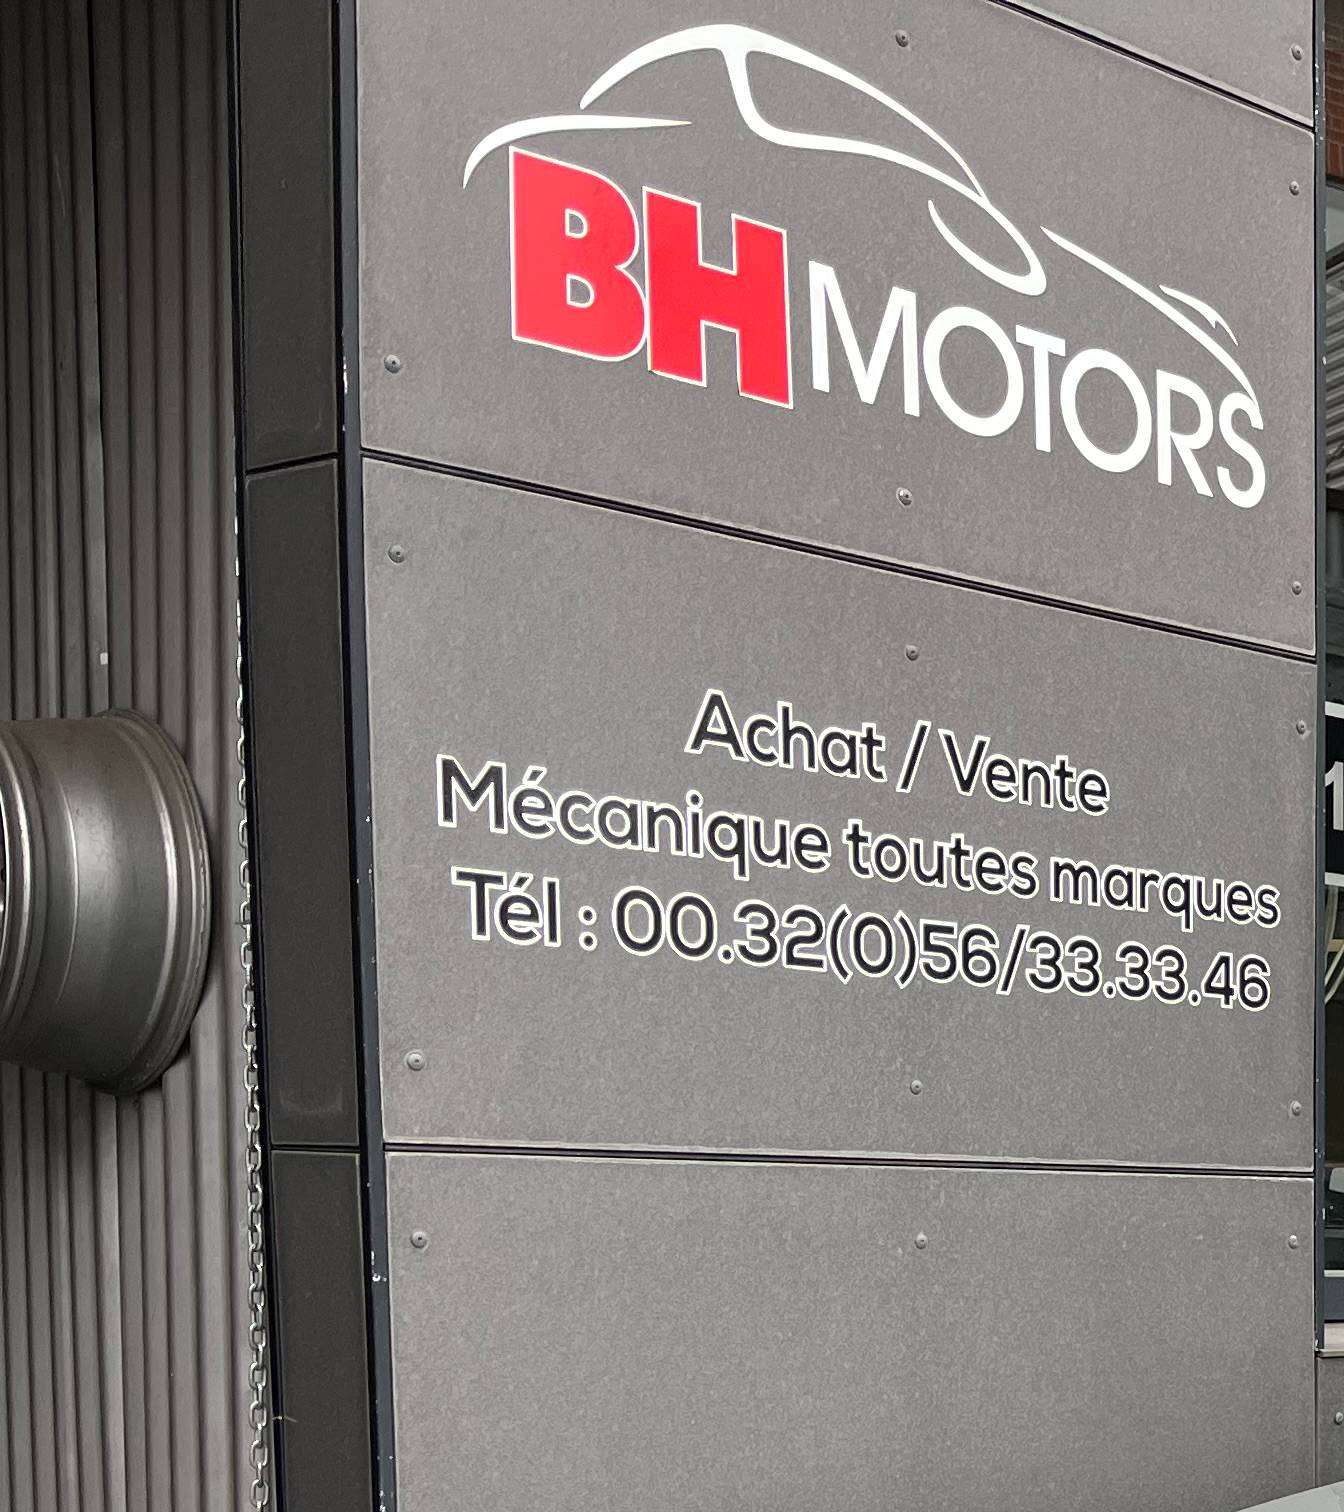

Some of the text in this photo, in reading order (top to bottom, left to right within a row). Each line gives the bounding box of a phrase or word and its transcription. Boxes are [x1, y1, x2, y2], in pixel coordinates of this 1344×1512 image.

[509, 146, 1266, 509] BH MOTORS
[684, 688, 1110, 816] Achat / Vente
[436, 753, 1281, 932] Mécanique toutes marques
[451, 865, 561, 947] Tél
[612, 885, 1271, 1011] 00.32(0)56/33.33.46
